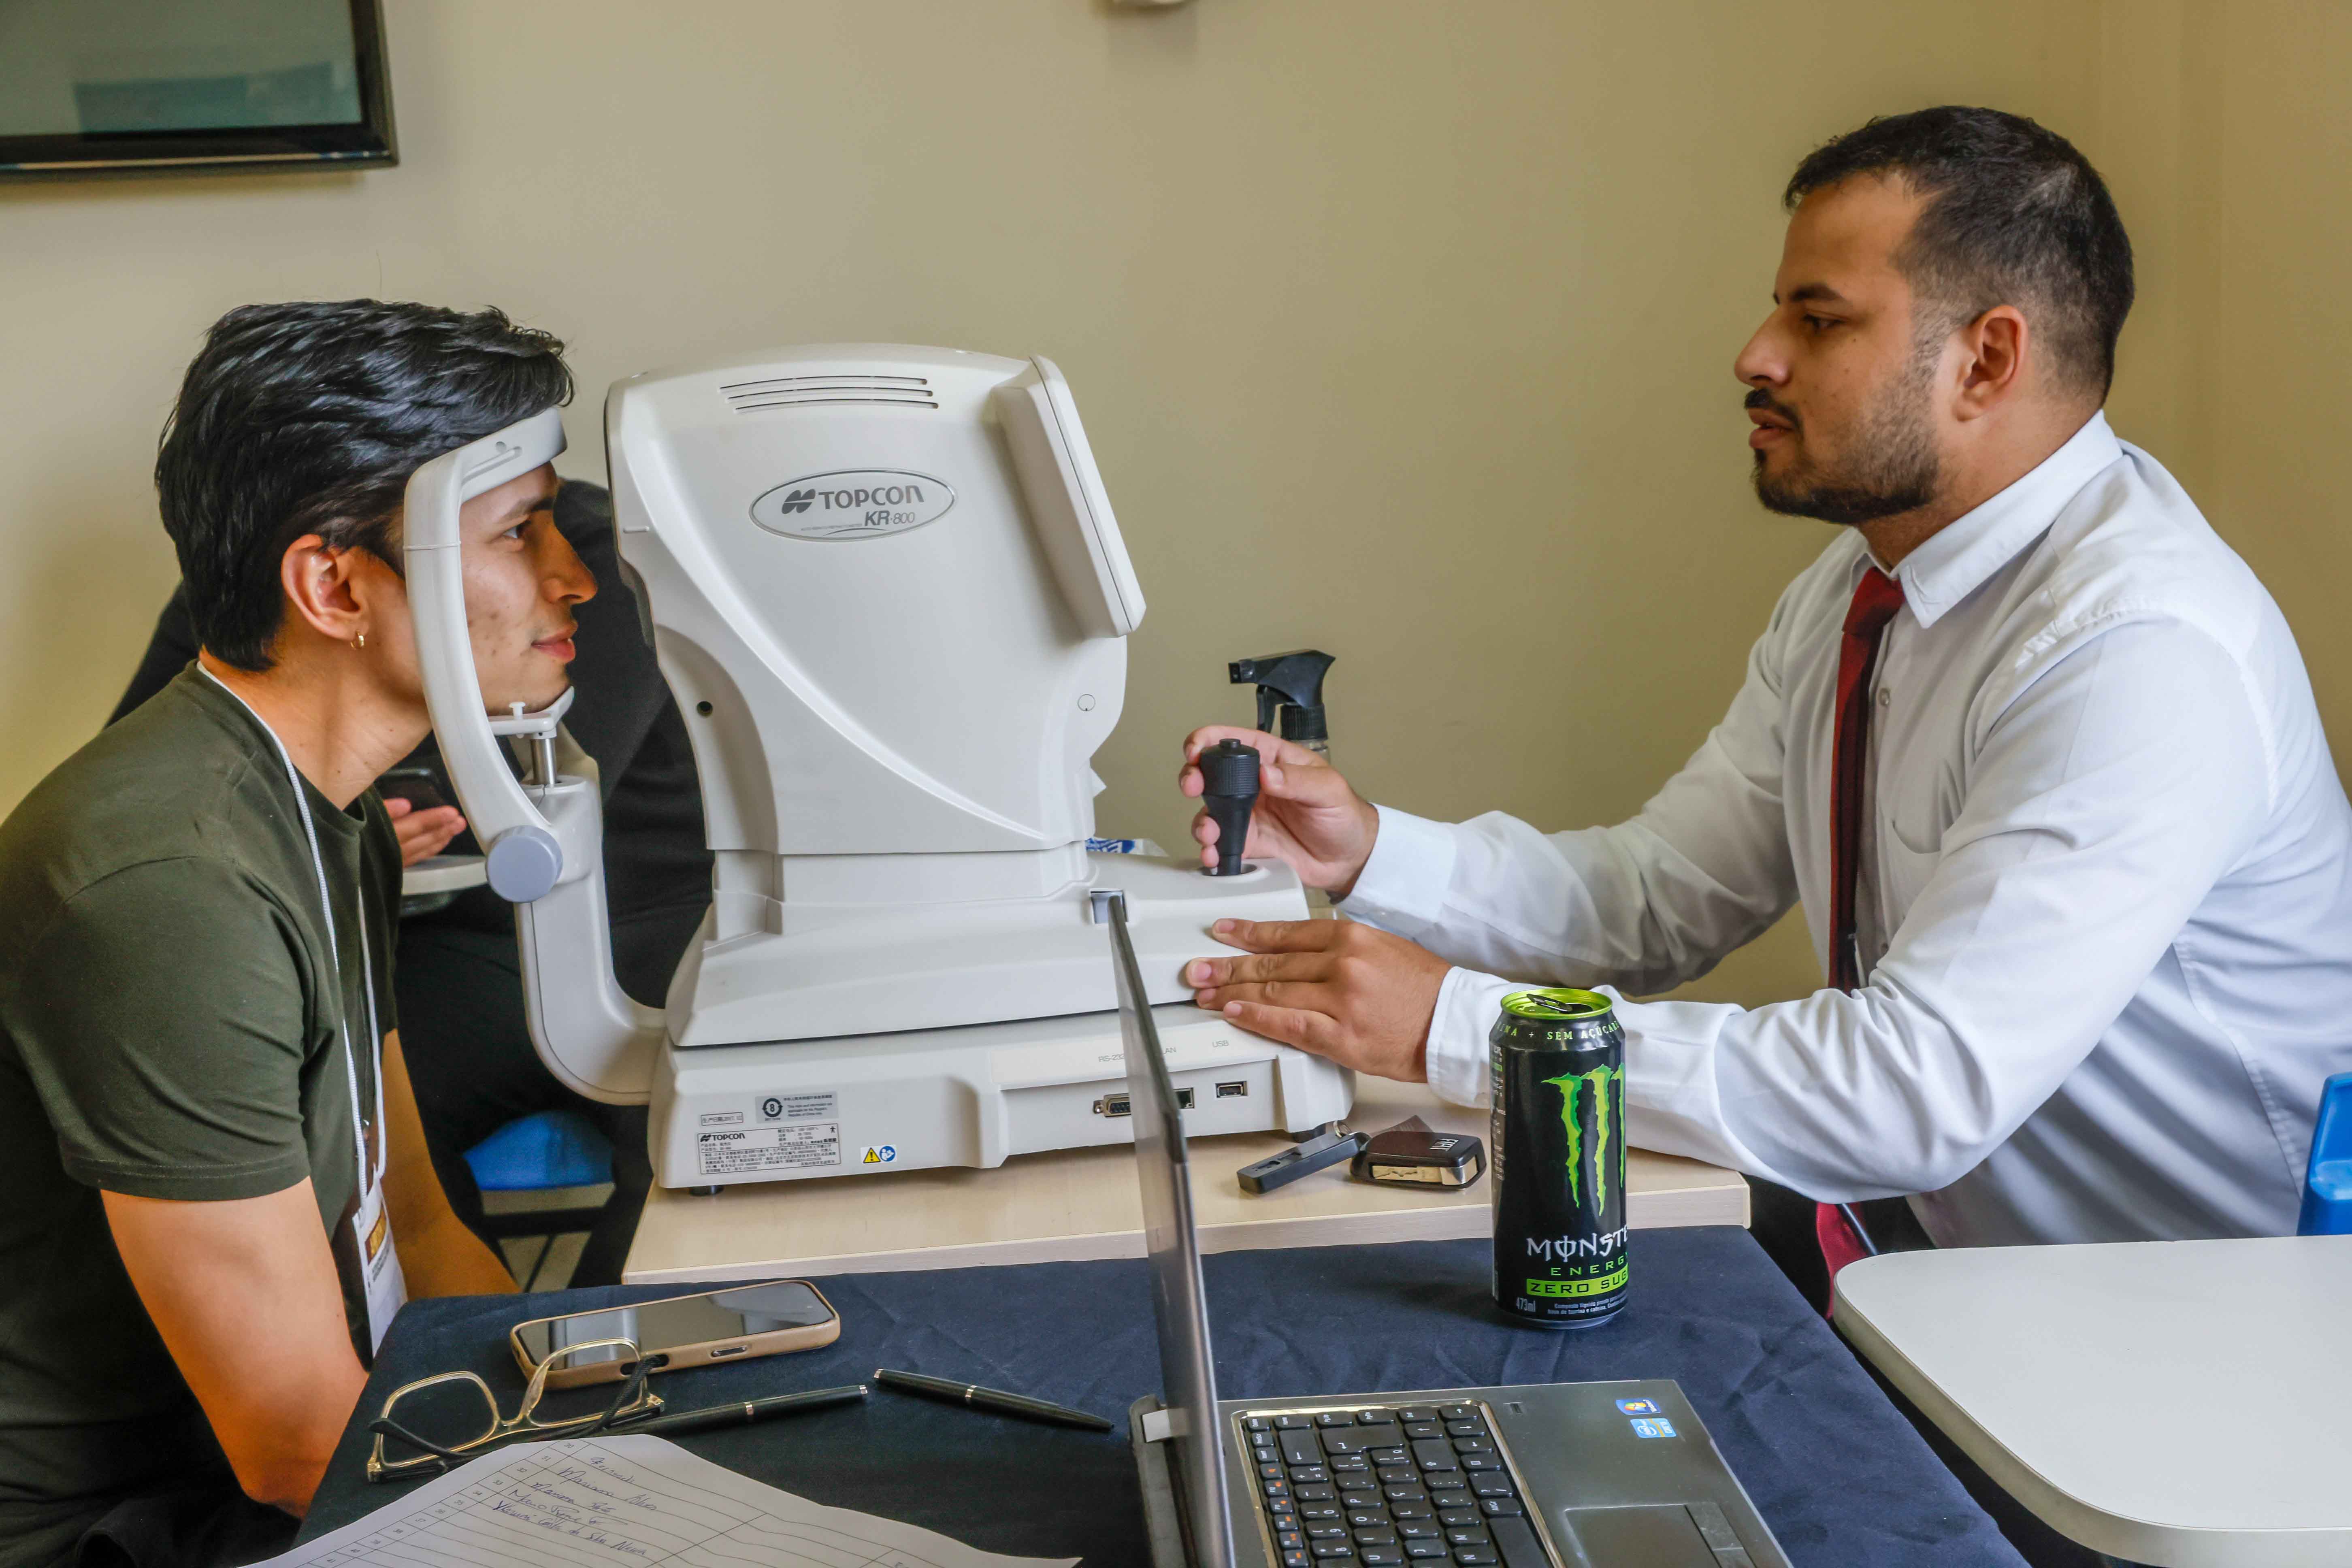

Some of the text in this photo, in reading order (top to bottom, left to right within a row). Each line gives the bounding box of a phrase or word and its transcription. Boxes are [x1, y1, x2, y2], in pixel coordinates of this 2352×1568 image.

[818, 485, 924, 509] TOPCON
[1547, 1031, 1573, 1040] SEM
[1212, 1040, 1229, 1048] USB
[712, 1133, 746, 1141] TOPCON
[1429, 1138, 1459, 1152] FIAT
[1551, 1252, 1628, 1276] ENERG
[1530, 1270, 1627, 1294] ZERO SUG
